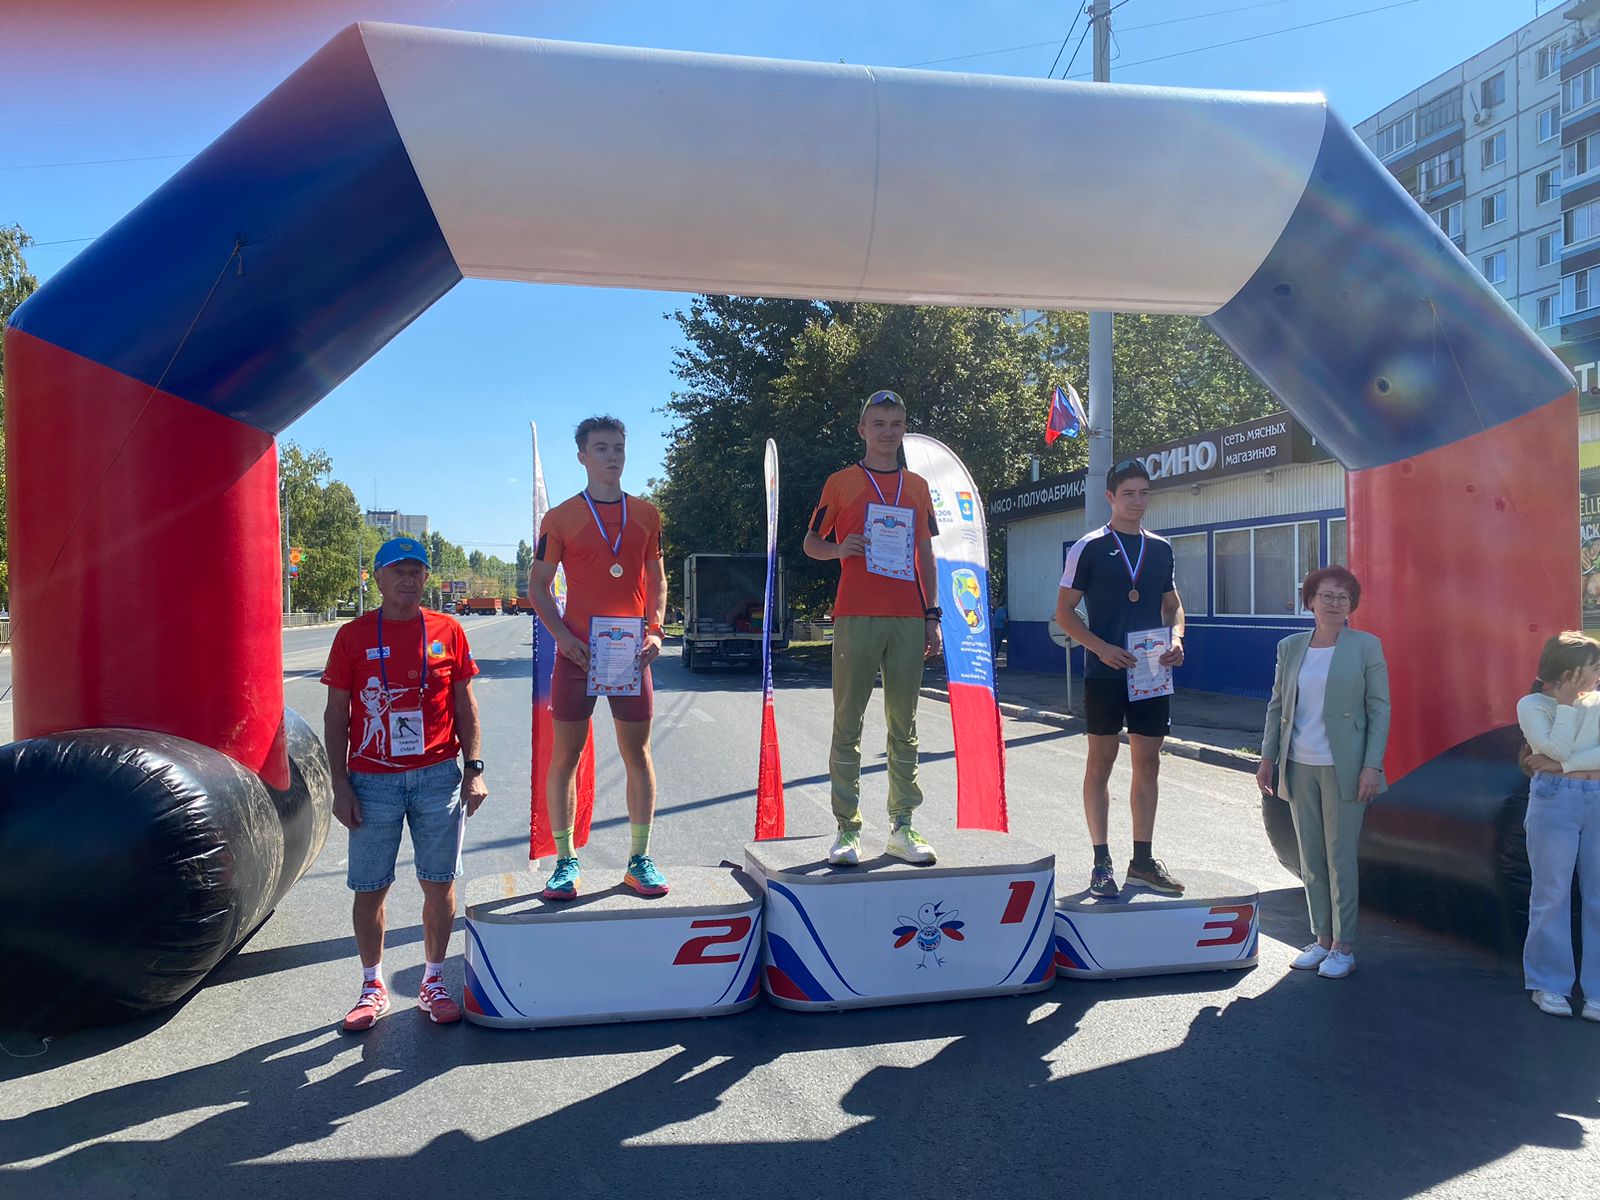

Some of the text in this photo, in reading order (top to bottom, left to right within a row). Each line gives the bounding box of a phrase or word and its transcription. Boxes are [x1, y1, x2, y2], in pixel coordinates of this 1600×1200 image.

[1574, 361, 1600, 392] Т
[1136, 441, 1217, 481] СИНО
[1225, 445, 1277, 466] магазинов
[990, 497, 1012, 515] МЯСО
[1000, 880, 1036, 924] 1
[672, 916, 752, 965] 2
[1196, 904, 1254, 947] 3
